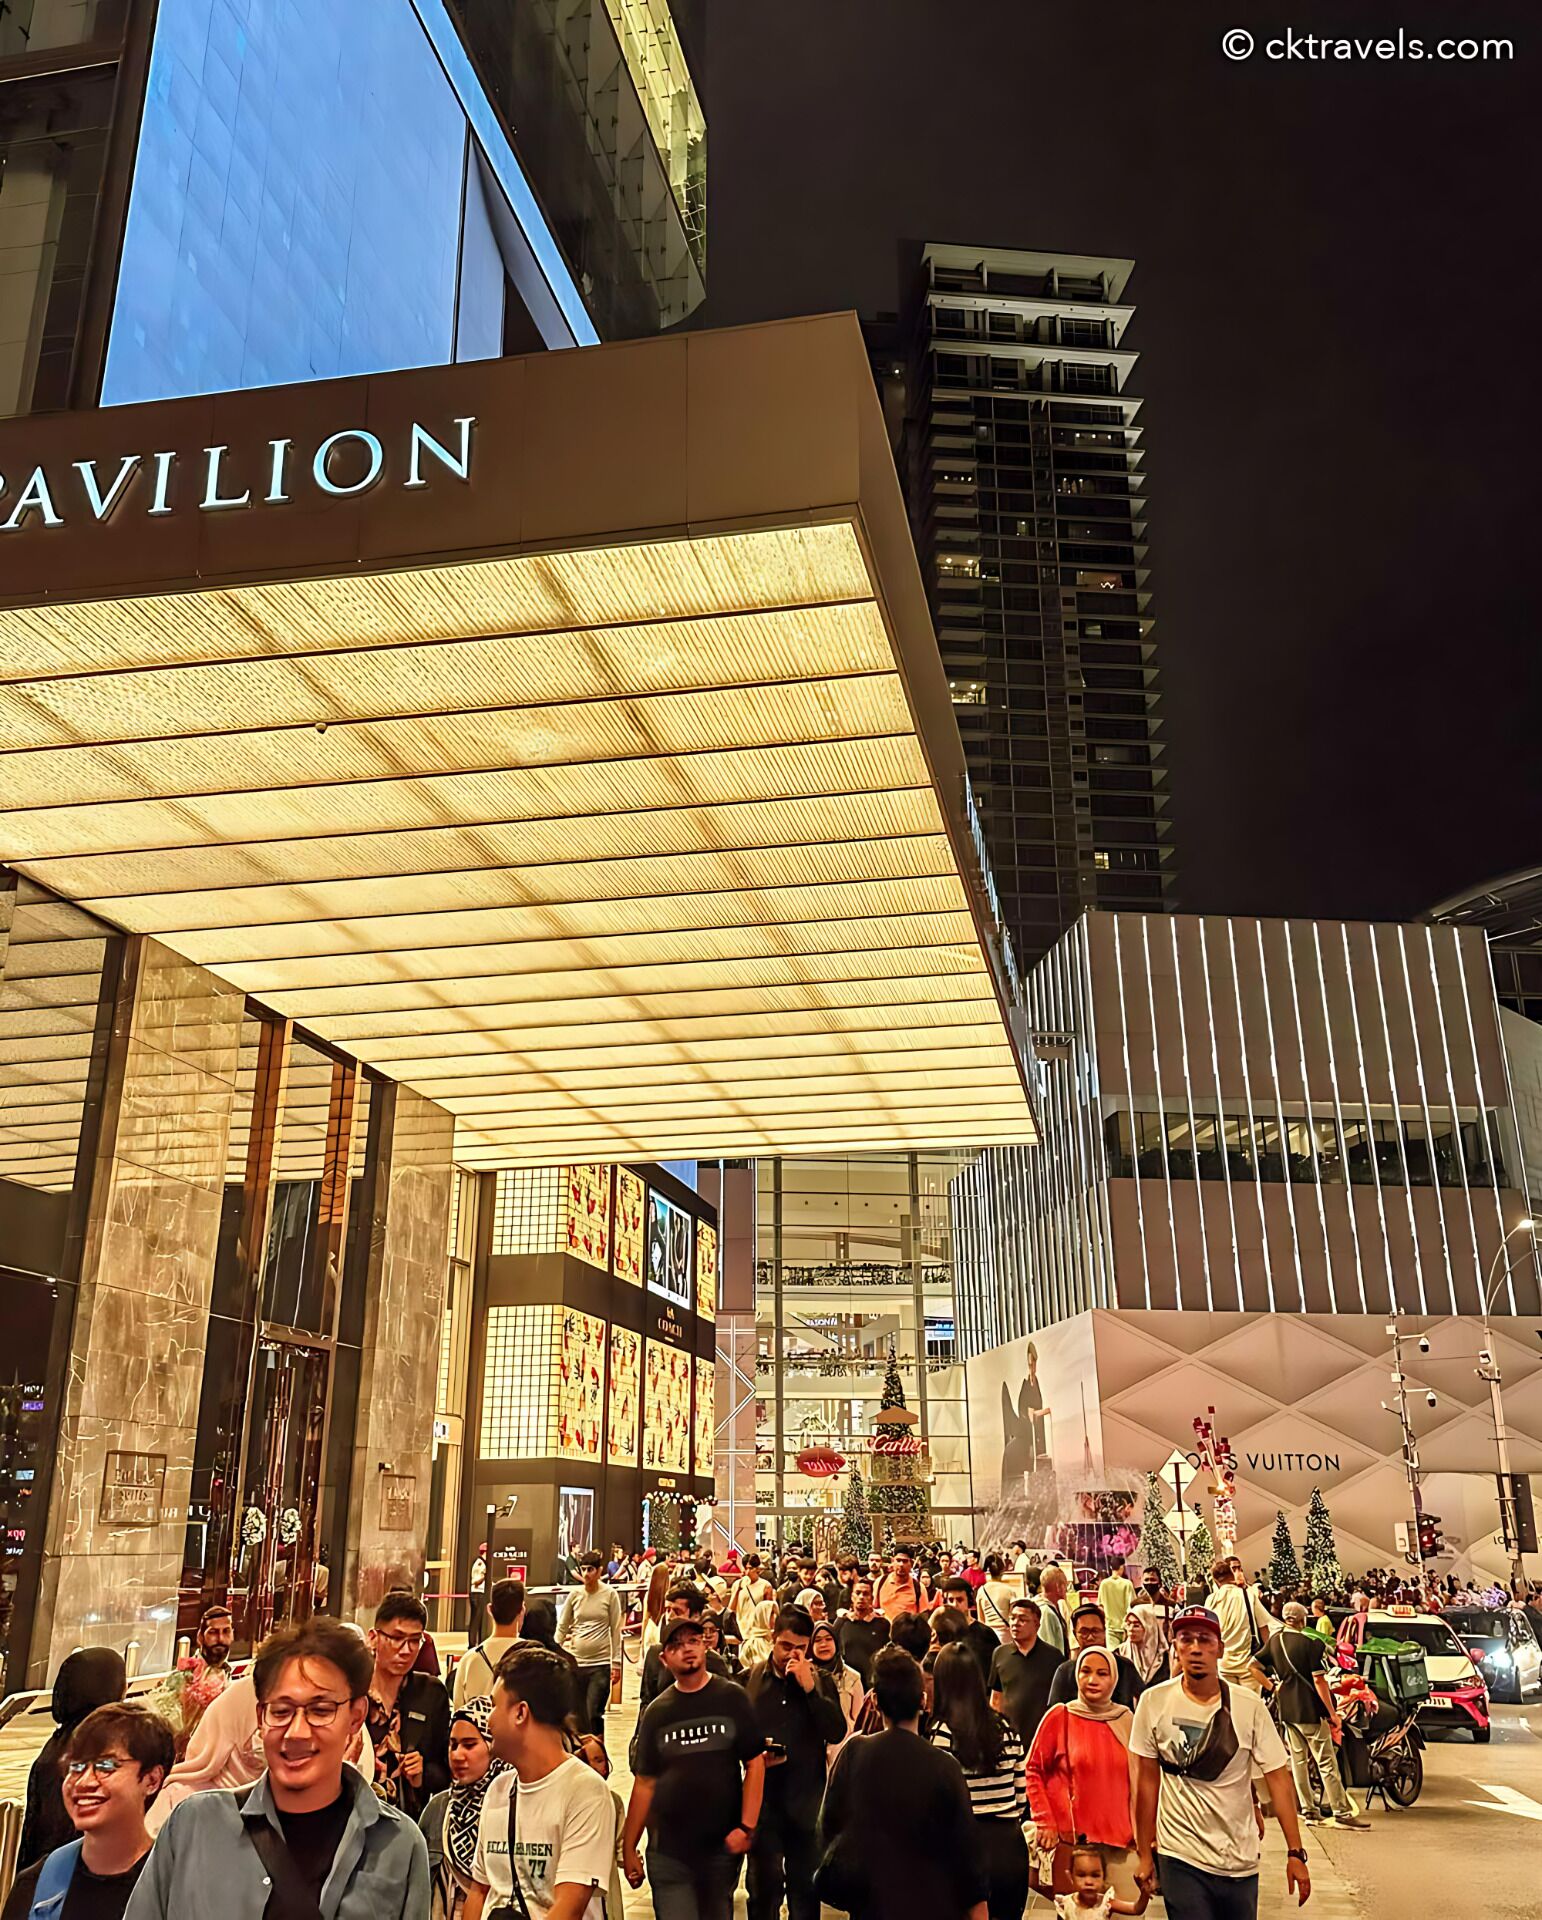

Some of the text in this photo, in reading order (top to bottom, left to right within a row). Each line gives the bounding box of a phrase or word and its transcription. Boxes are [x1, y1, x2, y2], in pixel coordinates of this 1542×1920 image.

[0, 415, 479, 530] AVILION
[1246, 1453, 1340, 1471] VUITTON
[528, 1858, 547, 1879] 77
